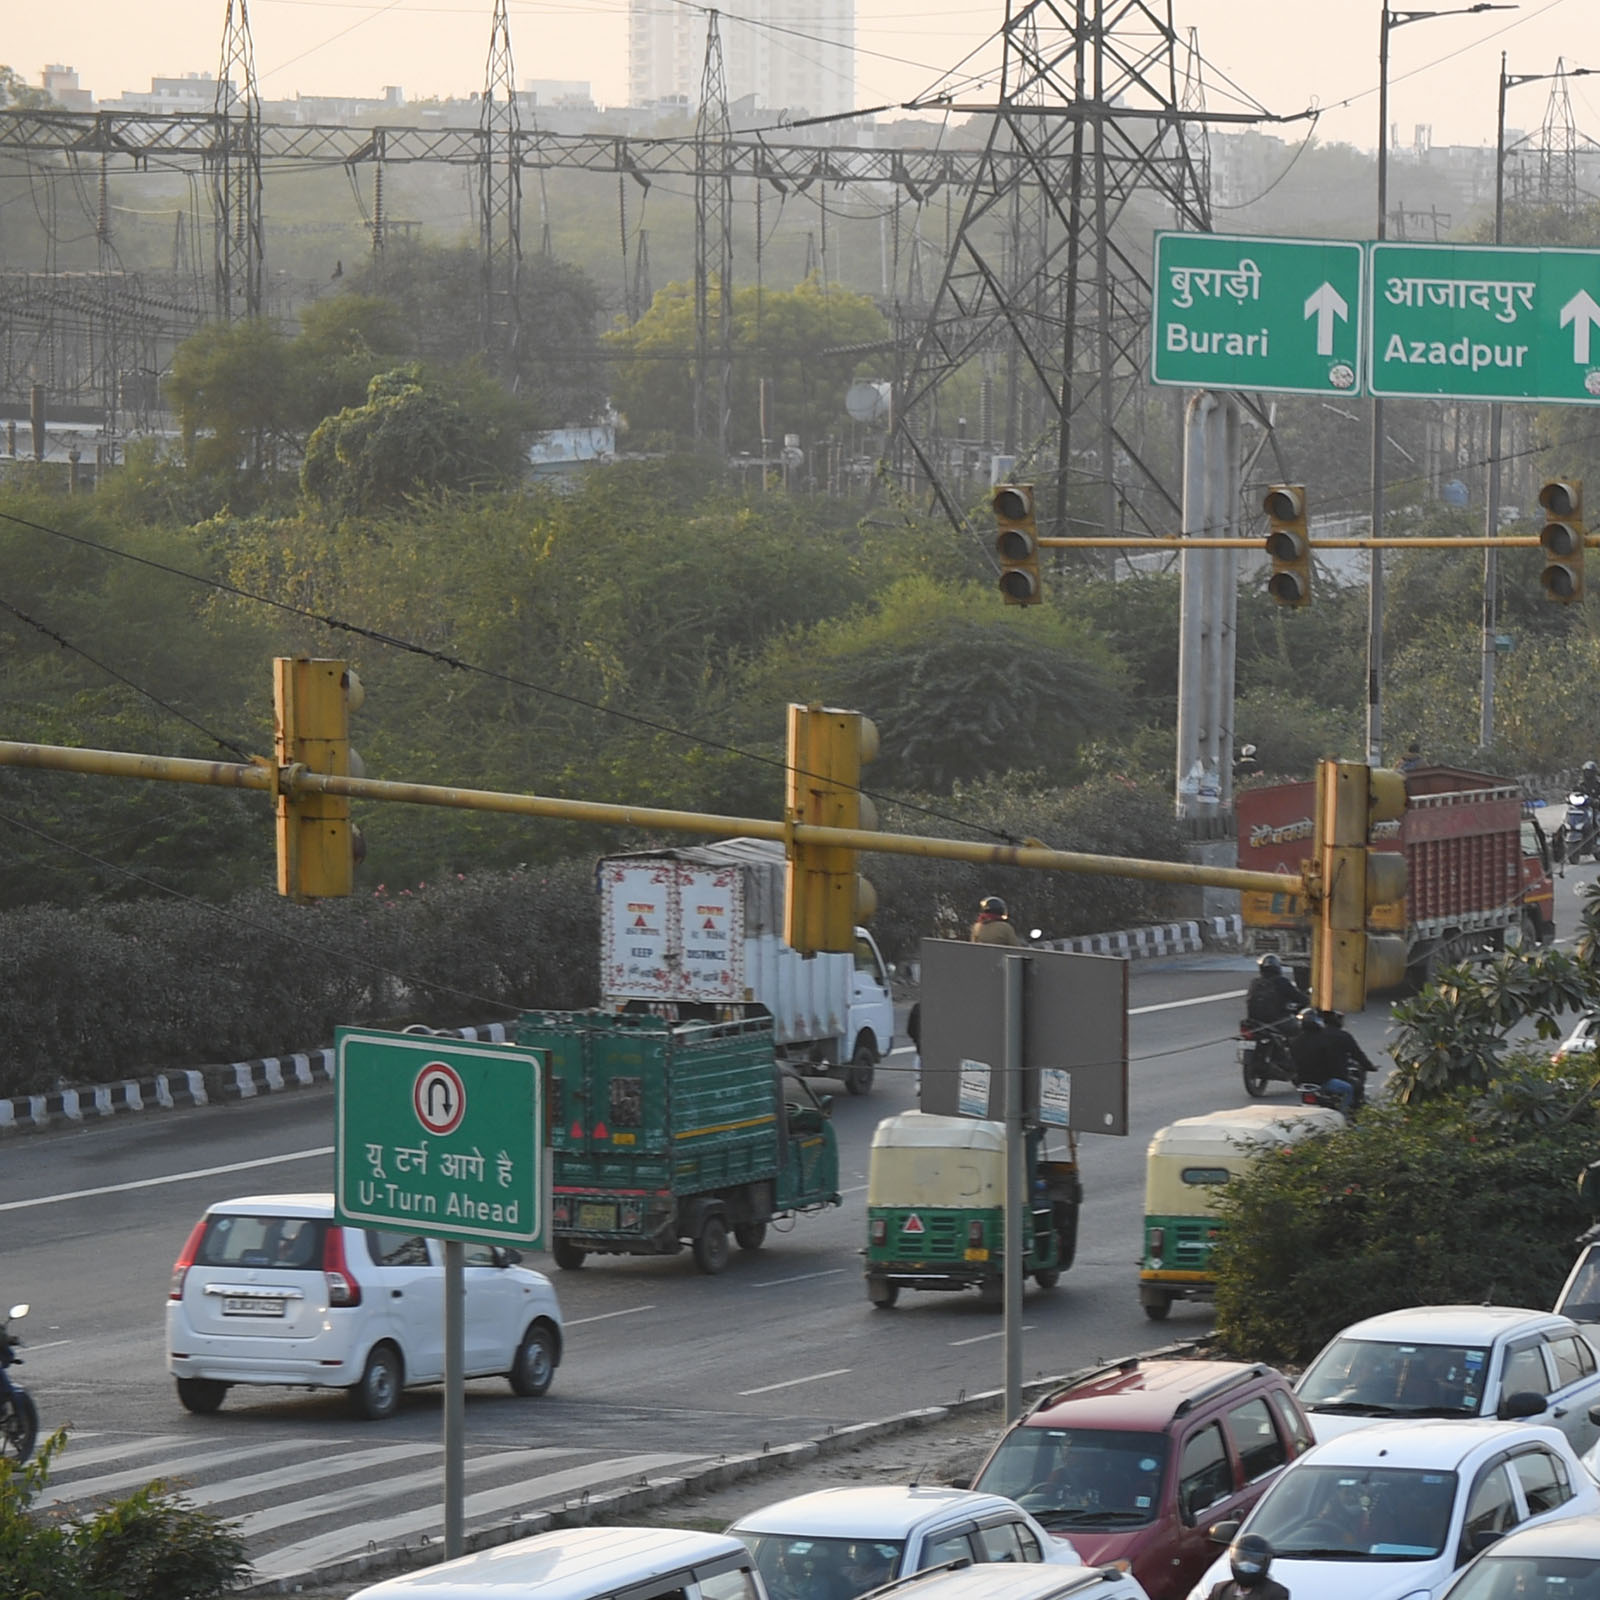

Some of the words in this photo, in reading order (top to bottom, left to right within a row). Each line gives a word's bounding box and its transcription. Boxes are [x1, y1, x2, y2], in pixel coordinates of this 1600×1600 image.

[1169, 257, 1262, 311] बुराड़ी
[1385, 275, 1535, 323] आजादपुर
[1165, 323, 1270, 358] Burari
[1383, 334, 1529, 373] Azadpur
[365, 1143, 387, 1179] यू
[395, 1141, 428, 1176] टर्न
[440, 1147, 485, 1182] आगे
[495, 1149, 514, 1188] है
[358, 1180, 437, 1214] U-Turn
[445, 1191, 519, 1225] Ahead
